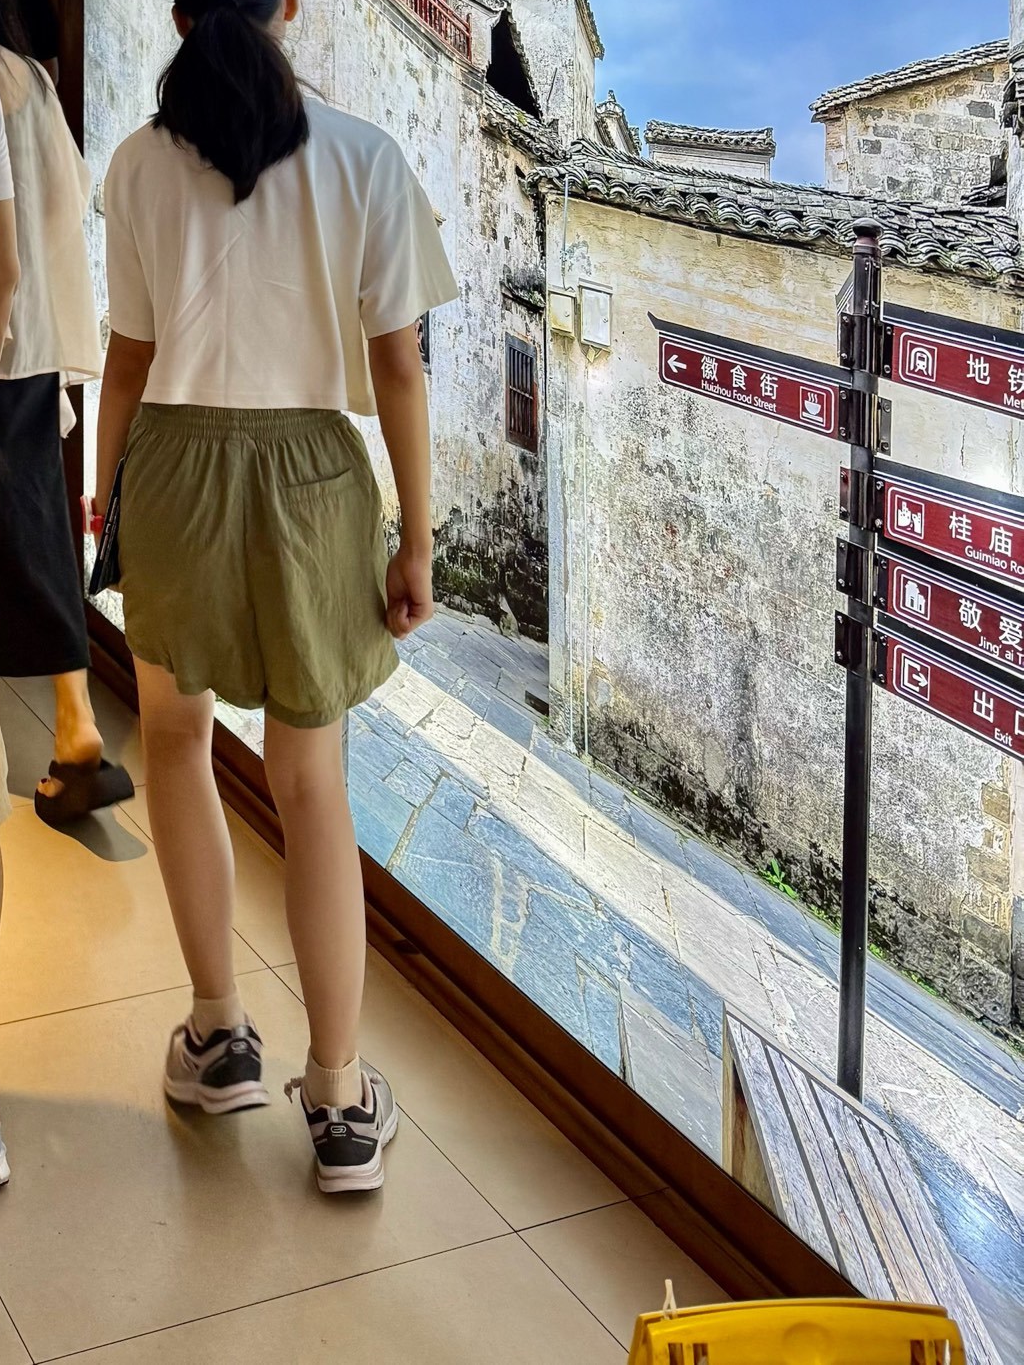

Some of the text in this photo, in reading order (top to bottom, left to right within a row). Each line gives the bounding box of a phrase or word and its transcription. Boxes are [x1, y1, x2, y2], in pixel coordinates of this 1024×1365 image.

[701, 355, 779, 400] 徽食街
[966, 353, 1024, 394] 地铁
[701, 379, 777, 413] Huizhou Food Street
[948, 511, 1014, 558] 桂庙
[964, 545, 1008, 570] Guimiao
[958, 598, 1024, 652] 敬爱
[1016, 651, 1024, 666] T
[994, 727, 1014, 748] Exit
